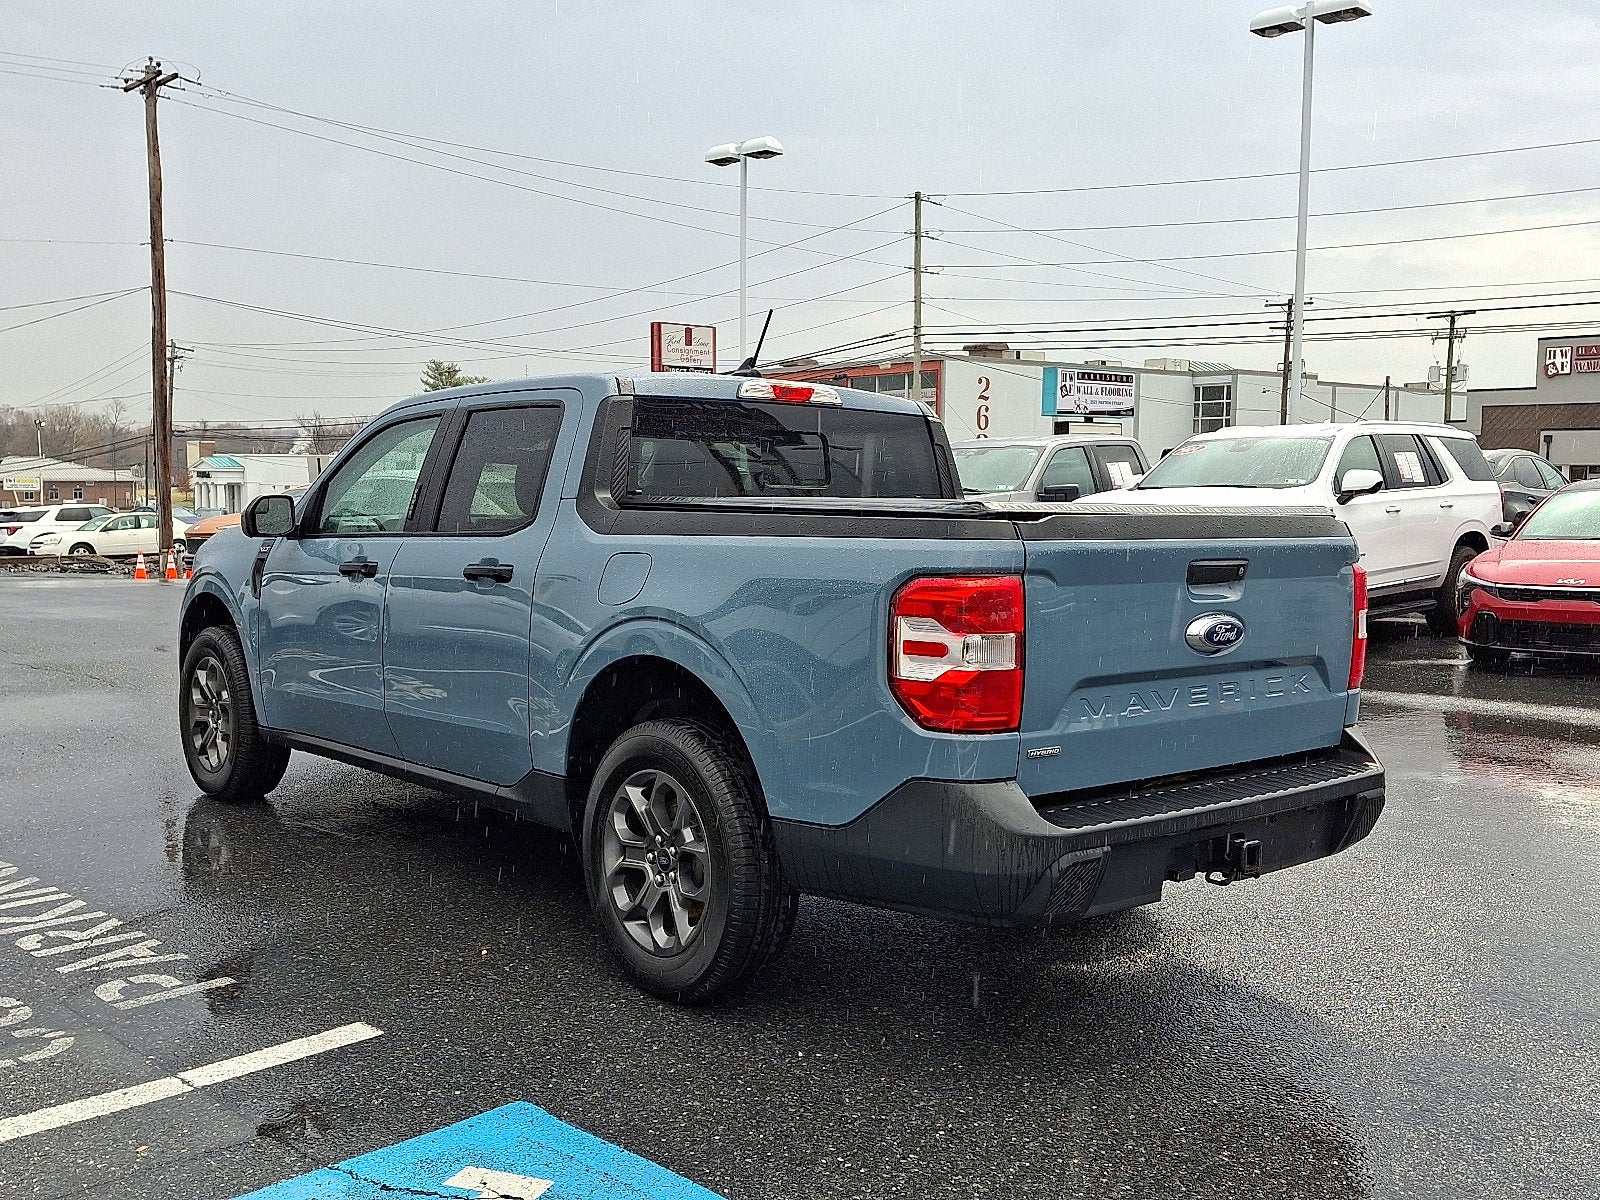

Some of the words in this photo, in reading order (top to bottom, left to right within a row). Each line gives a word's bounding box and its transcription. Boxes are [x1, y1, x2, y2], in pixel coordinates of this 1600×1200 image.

[667, 344, 710, 356] Consignment
[680, 354, 703, 365] Gallery
[1076, 385, 1094, 395] WALL
[1100, 386, 1133, 397] FLOORING
[1213, 624, 1238, 642] Ford
[1079, 673, 1311, 719] MAVERICK
[1029, 747, 1060, 757] HYBRID
